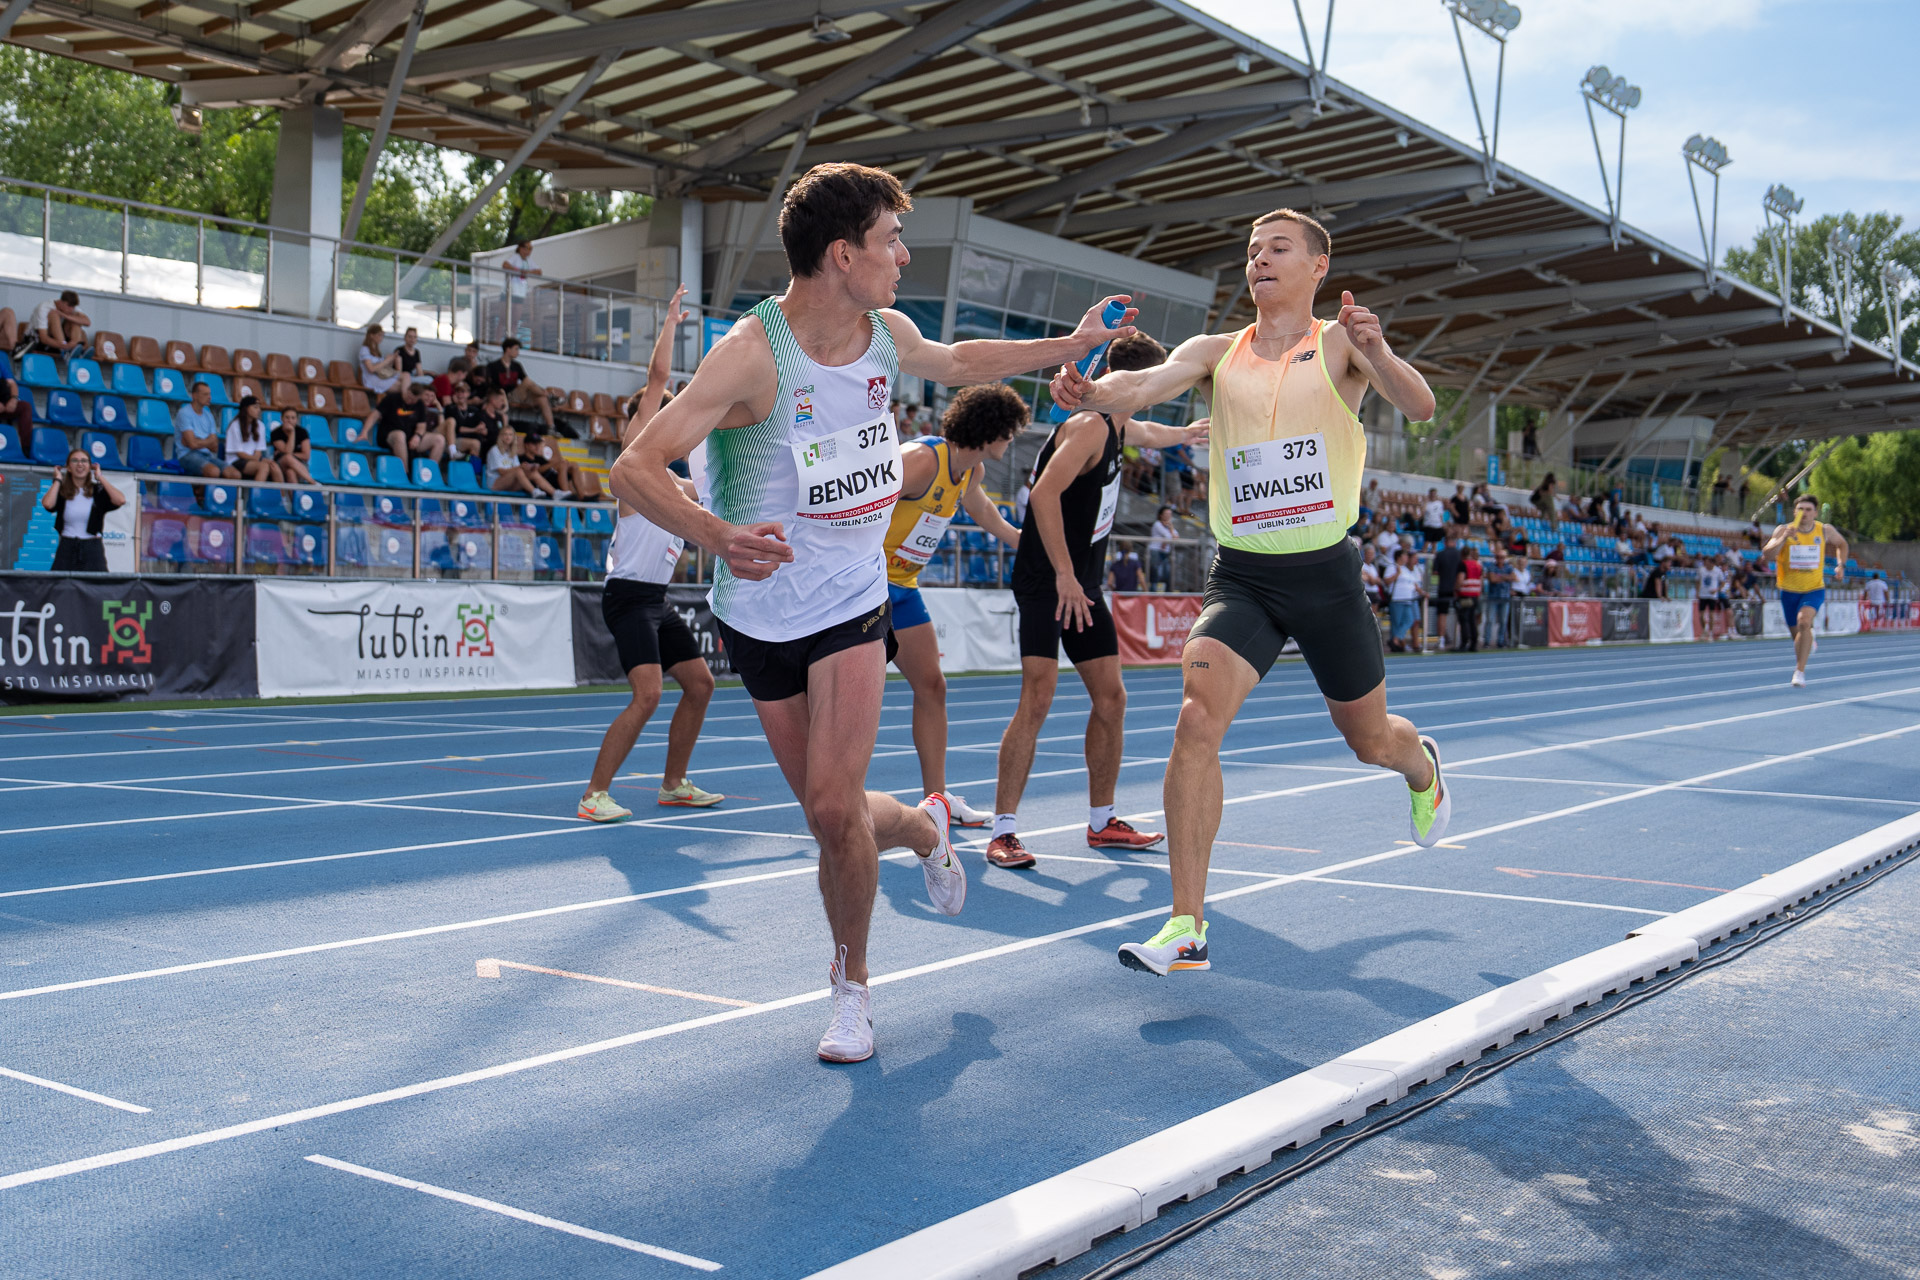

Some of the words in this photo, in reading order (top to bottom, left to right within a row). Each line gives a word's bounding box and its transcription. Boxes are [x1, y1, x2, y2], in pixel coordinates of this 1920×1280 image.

[857, 422, 889, 449] 372
[1282, 439, 1318, 460] 373
[809, 459, 897, 506] BENDYK
[1234, 472, 1324, 503] LEWALSKI
[830, 504, 874, 519] MISTRZOSTWA
[874, 498, 892, 509] POLSKI
[1255, 509, 1297, 520] MISTRZOSTWA
[1297, 505, 1317, 513] POLSKI
[1316, 502, 1328, 510] U23
[830, 518, 862, 527] LUBLIN
[862, 512, 883, 524] 2024
[1257, 519, 1285, 530] LUBLIN
[1285, 515, 1306, 526] 2024
[0, 600, 93, 666] blin
[357, 668, 411, 680] MIASTO
[419, 666, 495, 679] INSPIRACJI
[1190, 661, 1210, 669] run
[4, 676, 40, 690] STO
[50, 673, 154, 689] INSPIRACJI
